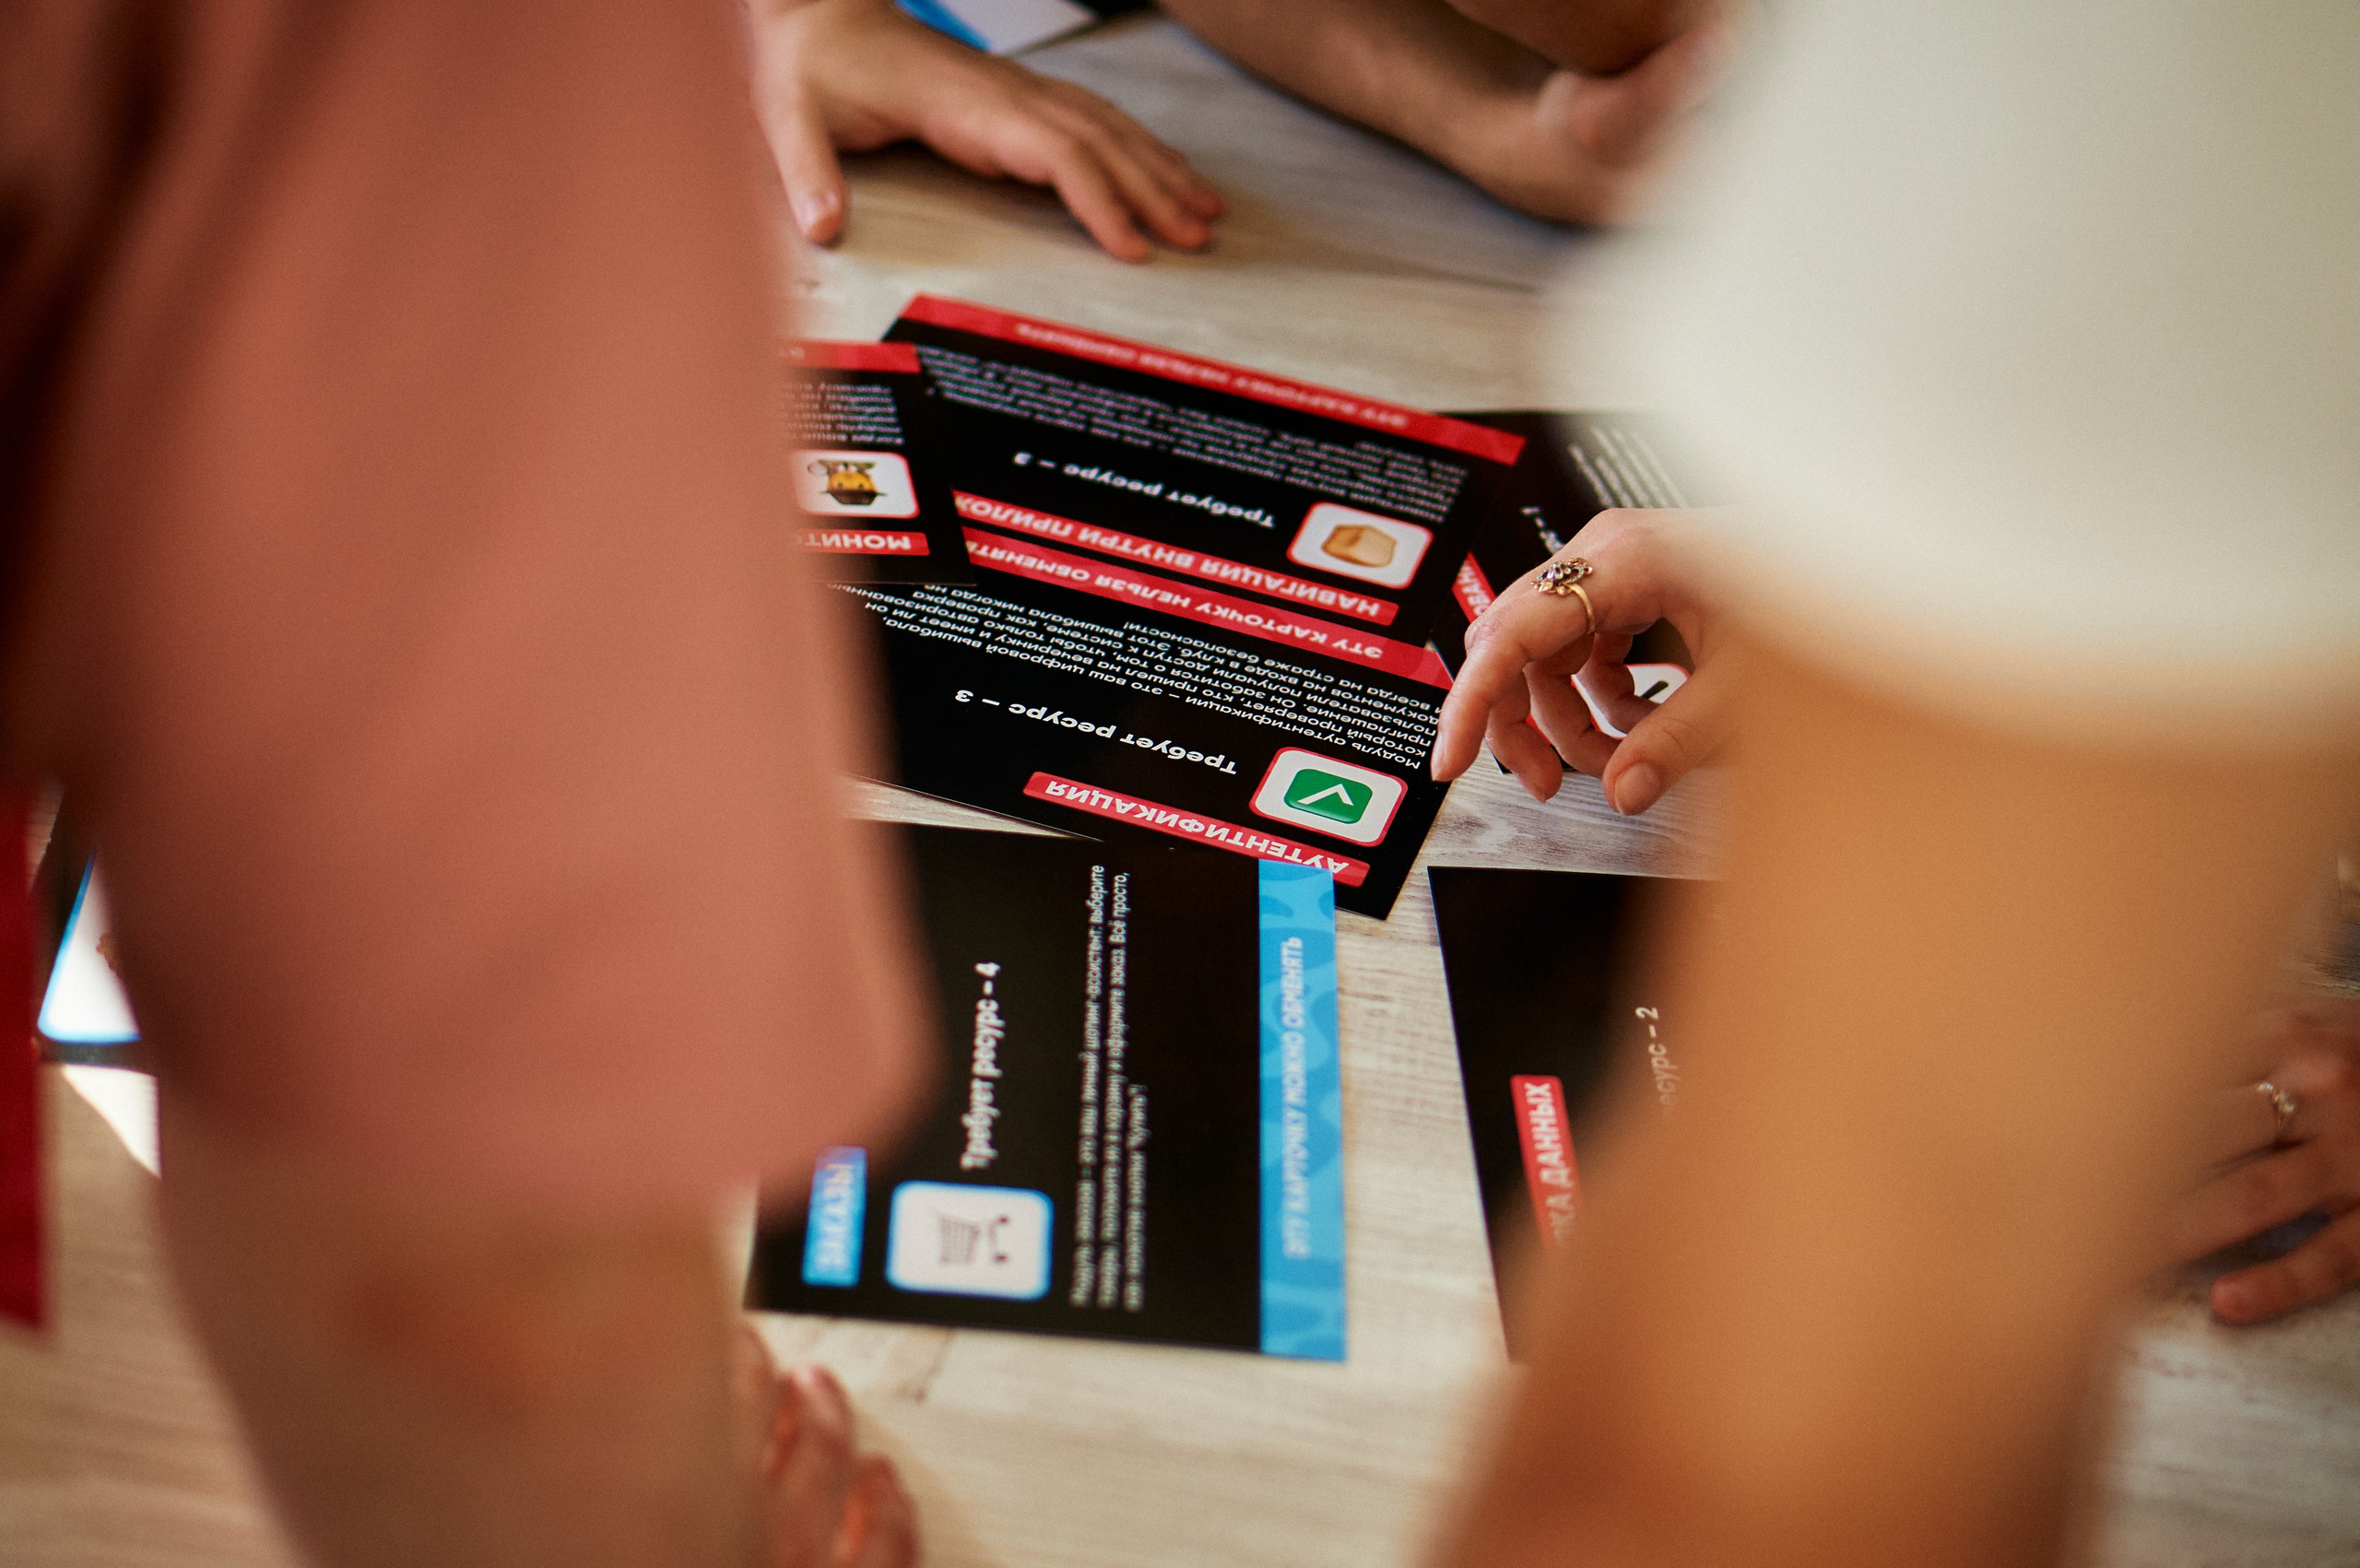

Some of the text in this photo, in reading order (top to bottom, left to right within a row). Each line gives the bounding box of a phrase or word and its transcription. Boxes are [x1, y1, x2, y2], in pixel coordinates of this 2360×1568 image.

[1013, 452, 1032, 465] 3
[1063, 464, 1163, 496] ресурс
[1165, 490, 1274, 527] Требует
[1077, 526, 1195, 569] ВНУТРИ
[1093, 573, 1191, 607] НЕЛЬЗЯ
[1198, 558, 1380, 616] НАВИГАЦИЯ
[881, 616, 983, 648] вышибала,
[983, 619, 1044, 641] только
[1194, 602, 1328, 644] КАРТОЧКУ
[924, 584, 1441, 726] документов на входе в клуб. Этот вышибала никогда не
[985, 643, 1085, 675] цифровой
[1049, 636, 1105, 656] чтобы
[1112, 651, 1148, 668] том,
[1122, 621, 1259, 664] безопасности!
[1331, 638, 1383, 658] ЭТУ
[863, 601, 1426, 758] который проверяет, кто пришел на вечеринку и имеет ли он
[912, 590, 1436, 737] пользователи получали доступ к системе, как проверка
[1088, 669, 1127, 686] ваш
[1153, 664, 1166, 672] о
[1263, 658, 1335, 682] страже
[954, 689, 974, 702] 3
[1130, 681, 1163, 695] это
[1169, 667, 1266, 699] заботится
[1338, 678, 1363, 690] на
[1365, 686, 1431, 711] всегда
[1268, 694, 1296, 708] Он
[1008, 702, 1117, 738] ресурс
[1185, 695, 1346, 745] аутентификации
[1303, 703, 1432, 747] приглашение.
[1118, 733, 1236, 774] Требует
[1351, 741, 1421, 769] Модуль
[1044, 780, 1350, 878] АУТЕНТИФИКАЦИЯ
[1085, 864, 1108, 924] выберите
[1111, 871, 1130, 917] просто,
[1108, 919, 1127, 945] Всё
[974, 961, 1000, 978] 4
[1109, 946, 1126, 986] заказ.
[1278, 936, 1306, 1029] ОБМЕНЯТЬ
[1105, 986, 1127, 1059] оформите
[1634, 1006, 1658, 1020] 2
[971, 998, 1004, 1078] ресурс
[960, 1077, 999, 1169] Требует
[1523, 1079, 1571, 1191] ДАННЫХ
